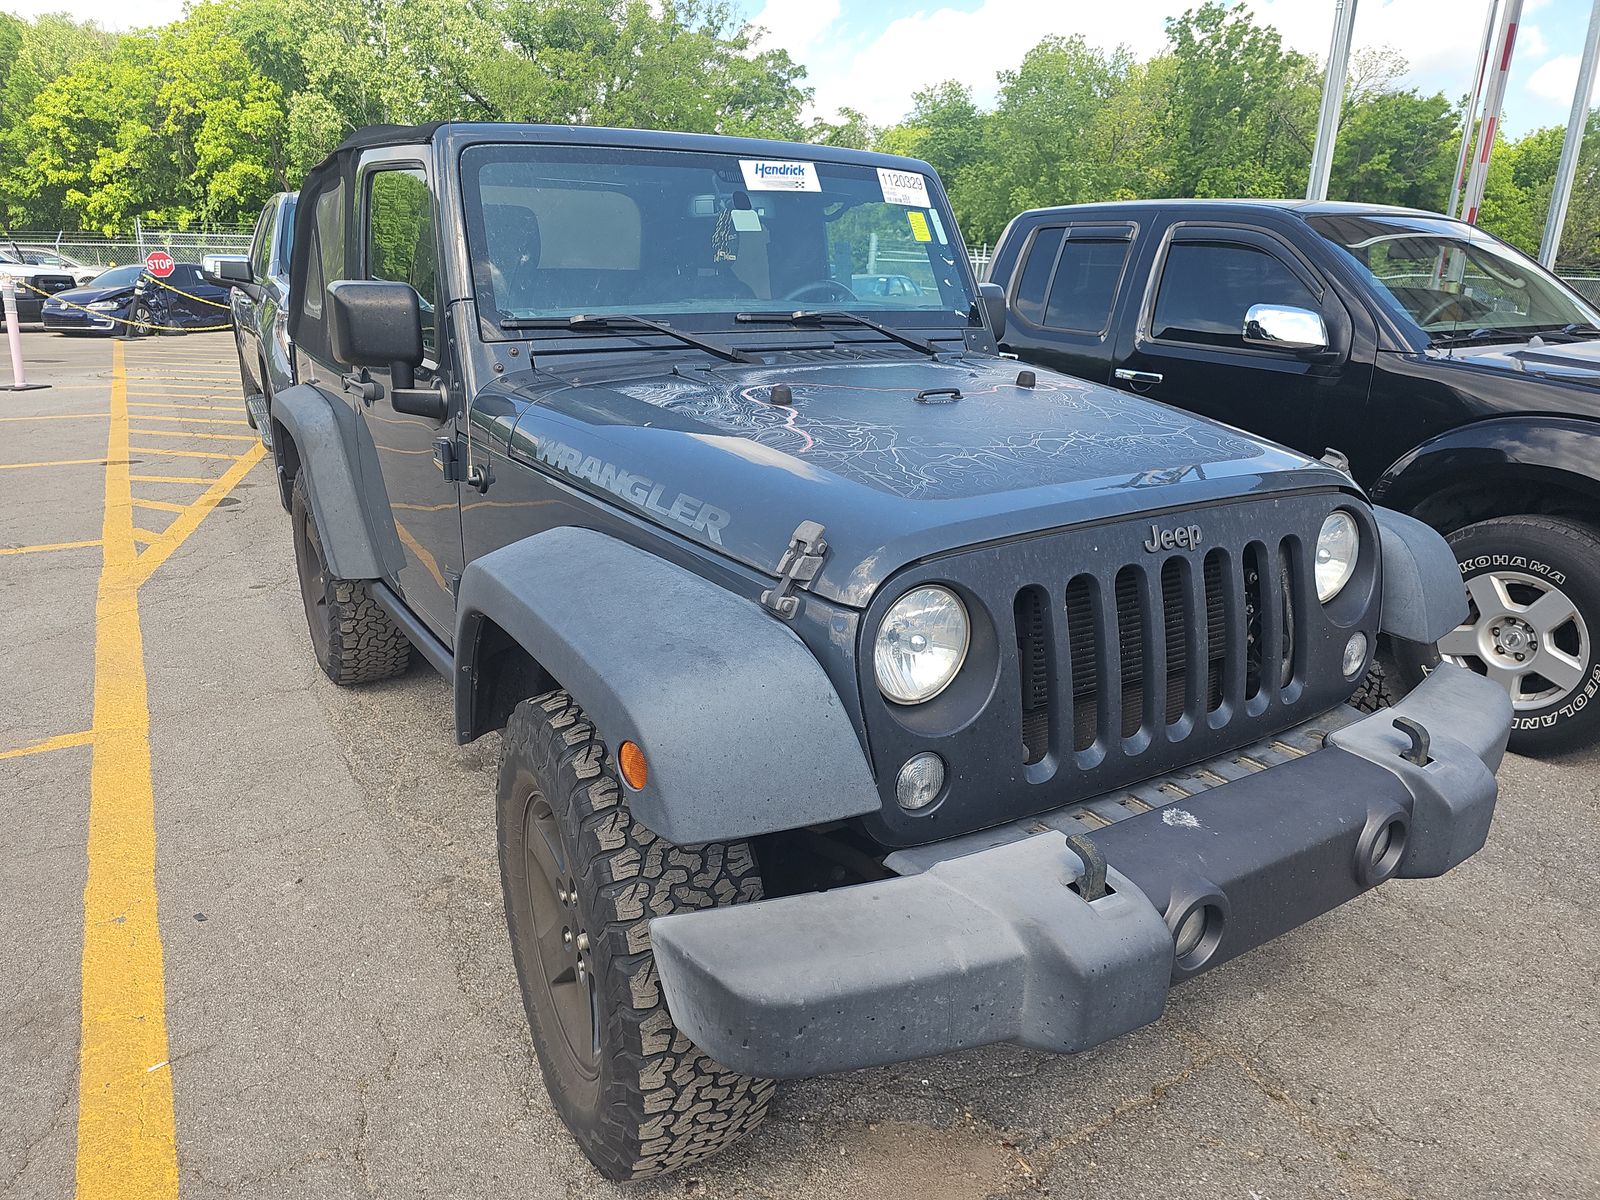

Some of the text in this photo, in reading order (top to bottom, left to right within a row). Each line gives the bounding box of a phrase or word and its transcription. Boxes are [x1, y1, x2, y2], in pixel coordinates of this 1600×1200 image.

[755, 162, 805, 178] Hendrick
[881, 172, 923, 191] 1120329
[148, 259, 172, 270] STOP
[536, 436, 732, 546] WRANGLER
[1144, 524, 1203, 553] Jeep
[1458, 555, 1567, 585] KOHAMA
